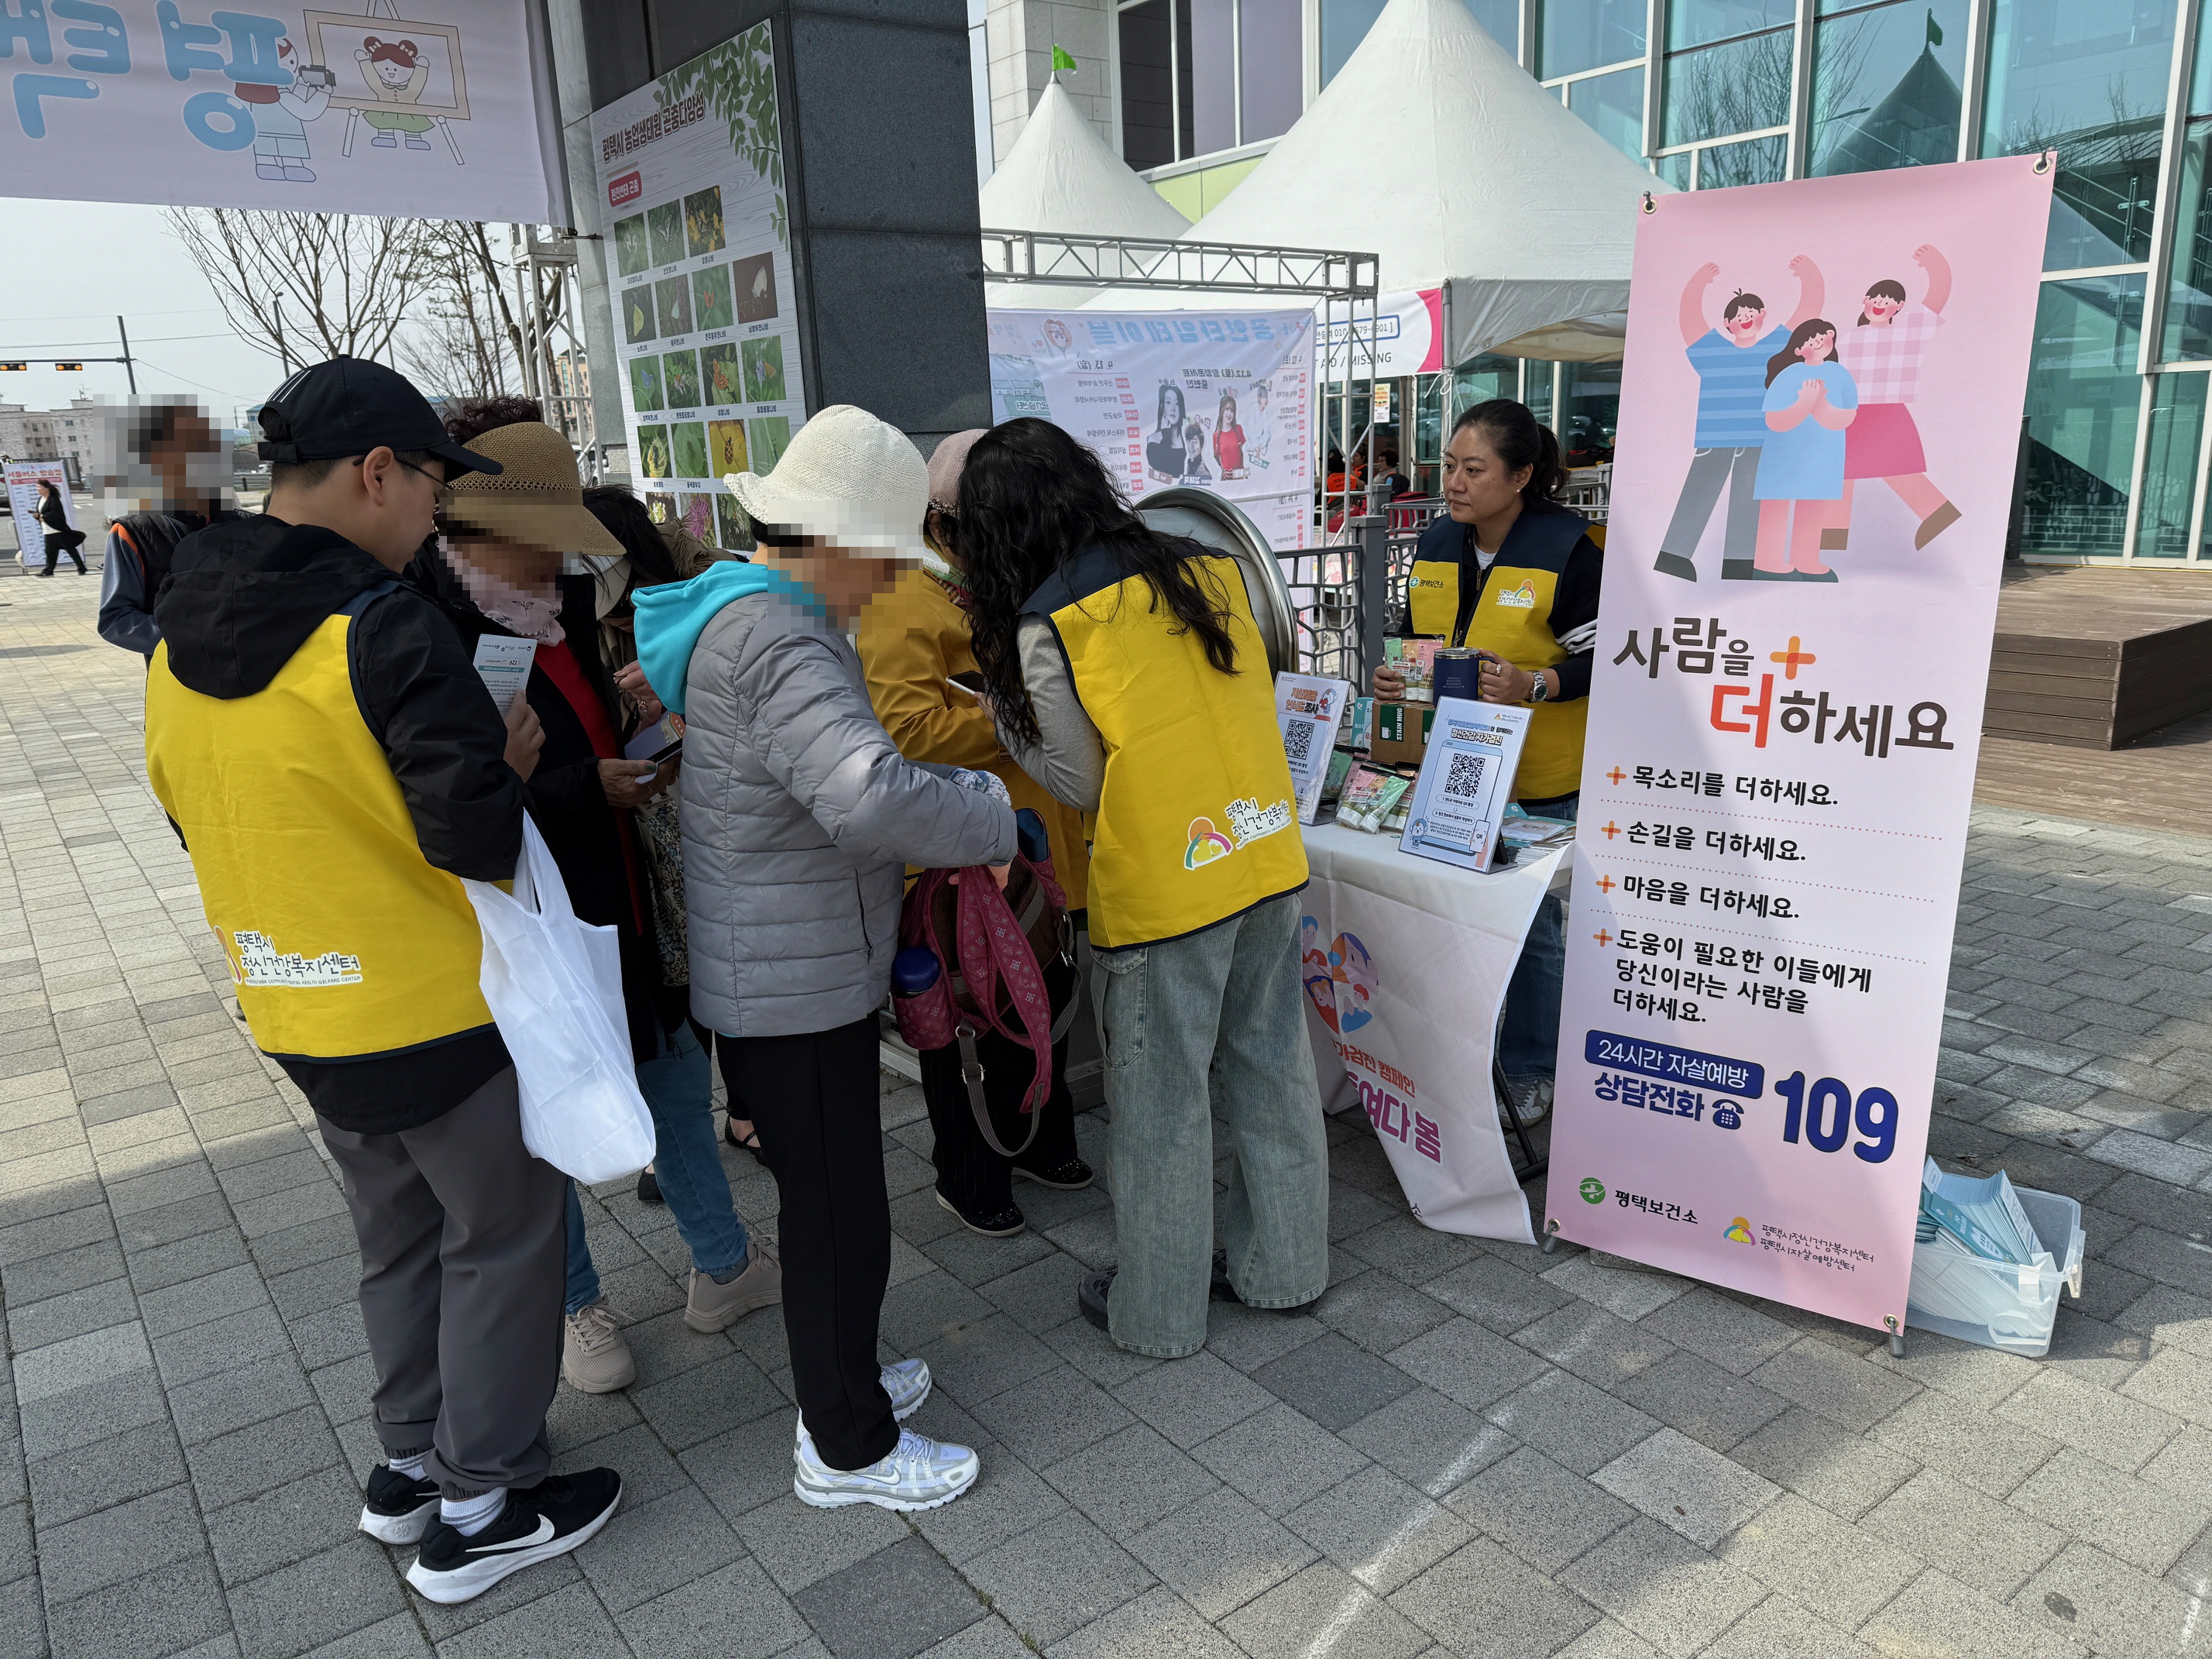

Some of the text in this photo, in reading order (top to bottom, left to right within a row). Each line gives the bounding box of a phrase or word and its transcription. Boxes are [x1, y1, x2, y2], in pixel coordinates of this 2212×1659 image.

[603, 90, 706, 163] 평택시 농업생태원 곤충다양성
[629, 179, 639, 194] 곤충
[1321, 357, 1337, 369] AD
[1419, 579, 1444, 589] 평택보건소
[1613, 617, 1755, 679] 사람을
[1304, 701, 1320, 716] 조사
[1709, 672, 1955, 759] 더하세요
[1632, 765, 1839, 806] 목소리를 더하세요.
[1225, 799, 1258, 822] 평택시
[1626, 821, 1807, 861] 손길을 더하세요.
[1623, 875, 1801, 919] 마음을 더하세요.
[235, 933, 275, 953] 평택시
[1616, 929, 1873, 993] 도움이 필요한 이들에게
[241, 953, 360, 977] 정신건강복지센터
[1613, 988, 1707, 1022] 더하세요.
[1616, 958, 1810, 1015] 당신이라는 사람을
[1378, 1060, 1416, 1099] 캠페인
[1597, 1039, 1750, 1089] 24시간 자살예방
[1593, 1070, 1899, 1164] 상담전화 109
[1614, 1190, 1698, 1225] 평택보건소
[1760, 1223, 1874, 1263] 평택시정신건강복지센터
